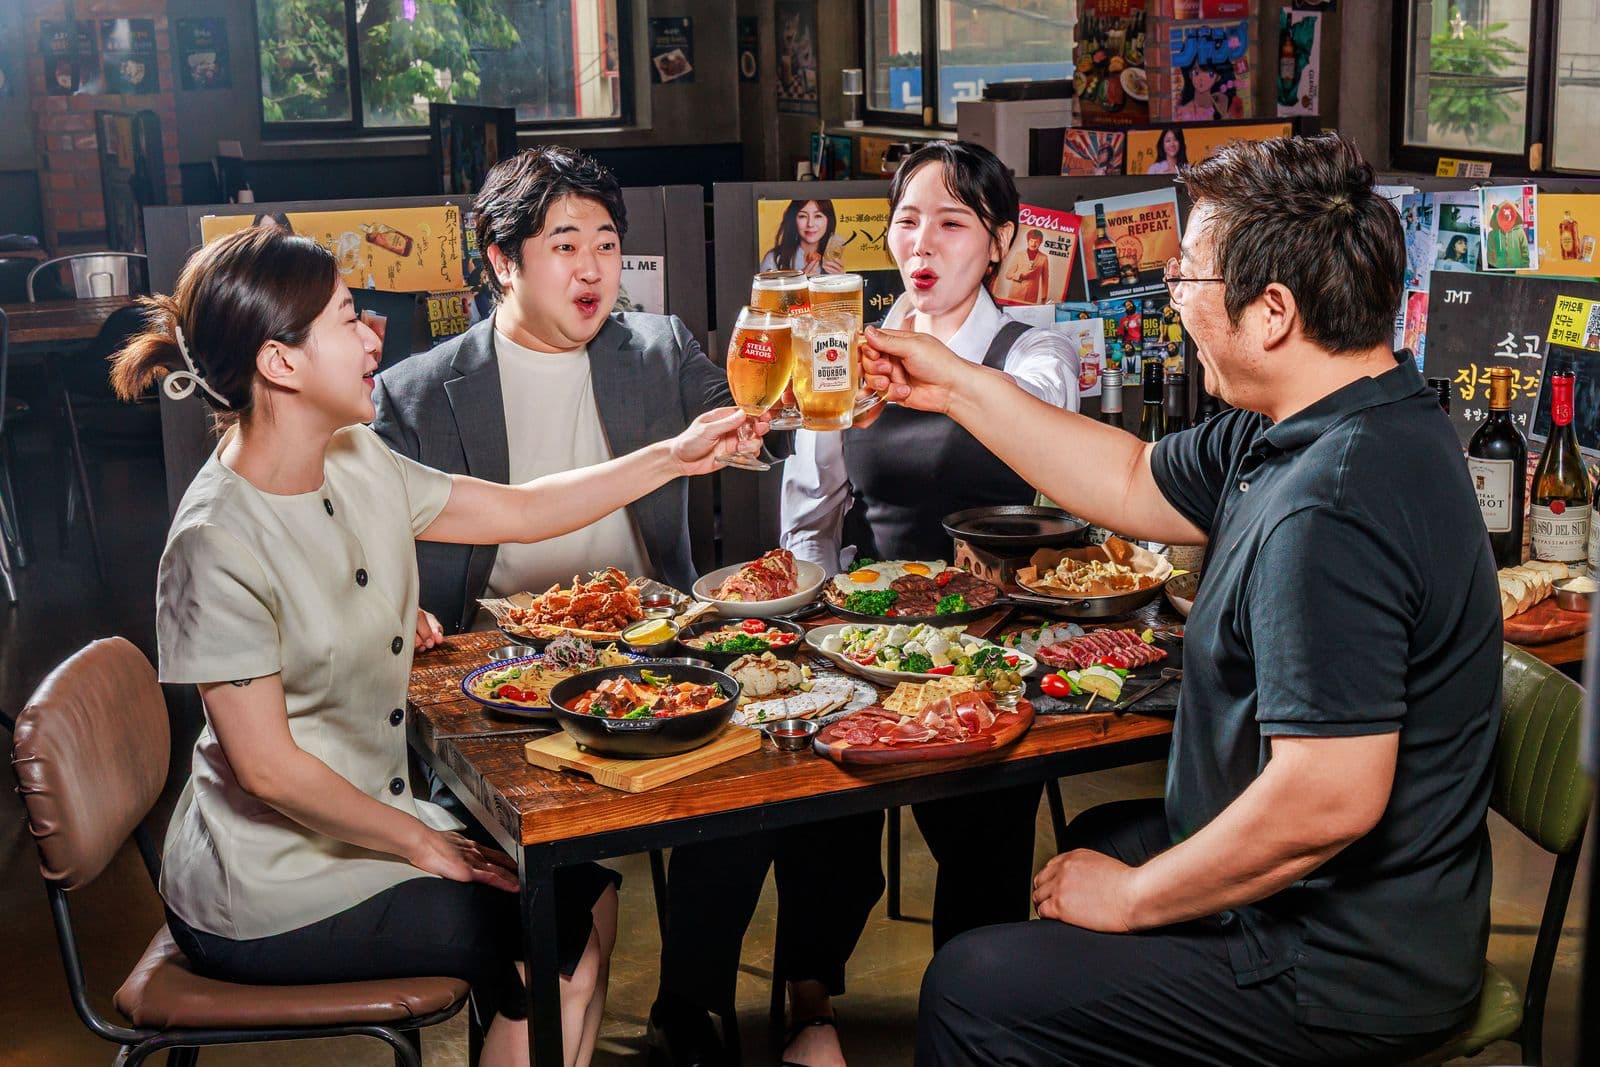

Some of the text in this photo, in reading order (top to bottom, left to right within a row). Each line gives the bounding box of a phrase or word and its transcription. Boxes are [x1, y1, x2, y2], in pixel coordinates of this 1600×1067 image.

[1019, 208, 1059, 230] Coors
[1108, 209, 1171, 227] WORK. RELAX.
[1128, 220, 1172, 236] REPEAT.
[1058, 235, 1064, 243] is
[1044, 240, 1072, 251] SEXY
[1049, 250, 1070, 258] man!
[621, 261, 657, 270] LL ME
[869, 294, 894, 311] 버터
[1443, 290, 1472, 304] JMT
[428, 296, 462, 321] BIG
[790, 307, 810, 316] STELLA
[1559, 299, 1584, 314] 카카오톡
[1104, 318, 1115, 329] IG
[1143, 318, 1158, 329] BIG
[1555, 314, 1573, 327] 친구는
[430, 319, 467, 338] PEAT
[1104, 329, 1117, 337] EAT
[1143, 328, 1159, 337] PEAT
[746, 342, 772, 353] STELLA
[814, 337, 848, 353] JIM BEAM
[745, 349, 772, 359] ARTOIS
[818, 368, 847, 377] BOURBON
[1479, 499, 1505, 508] BOT
[1555, 524, 1570, 536] DEL
[1572, 521, 1586, 536] SUD
